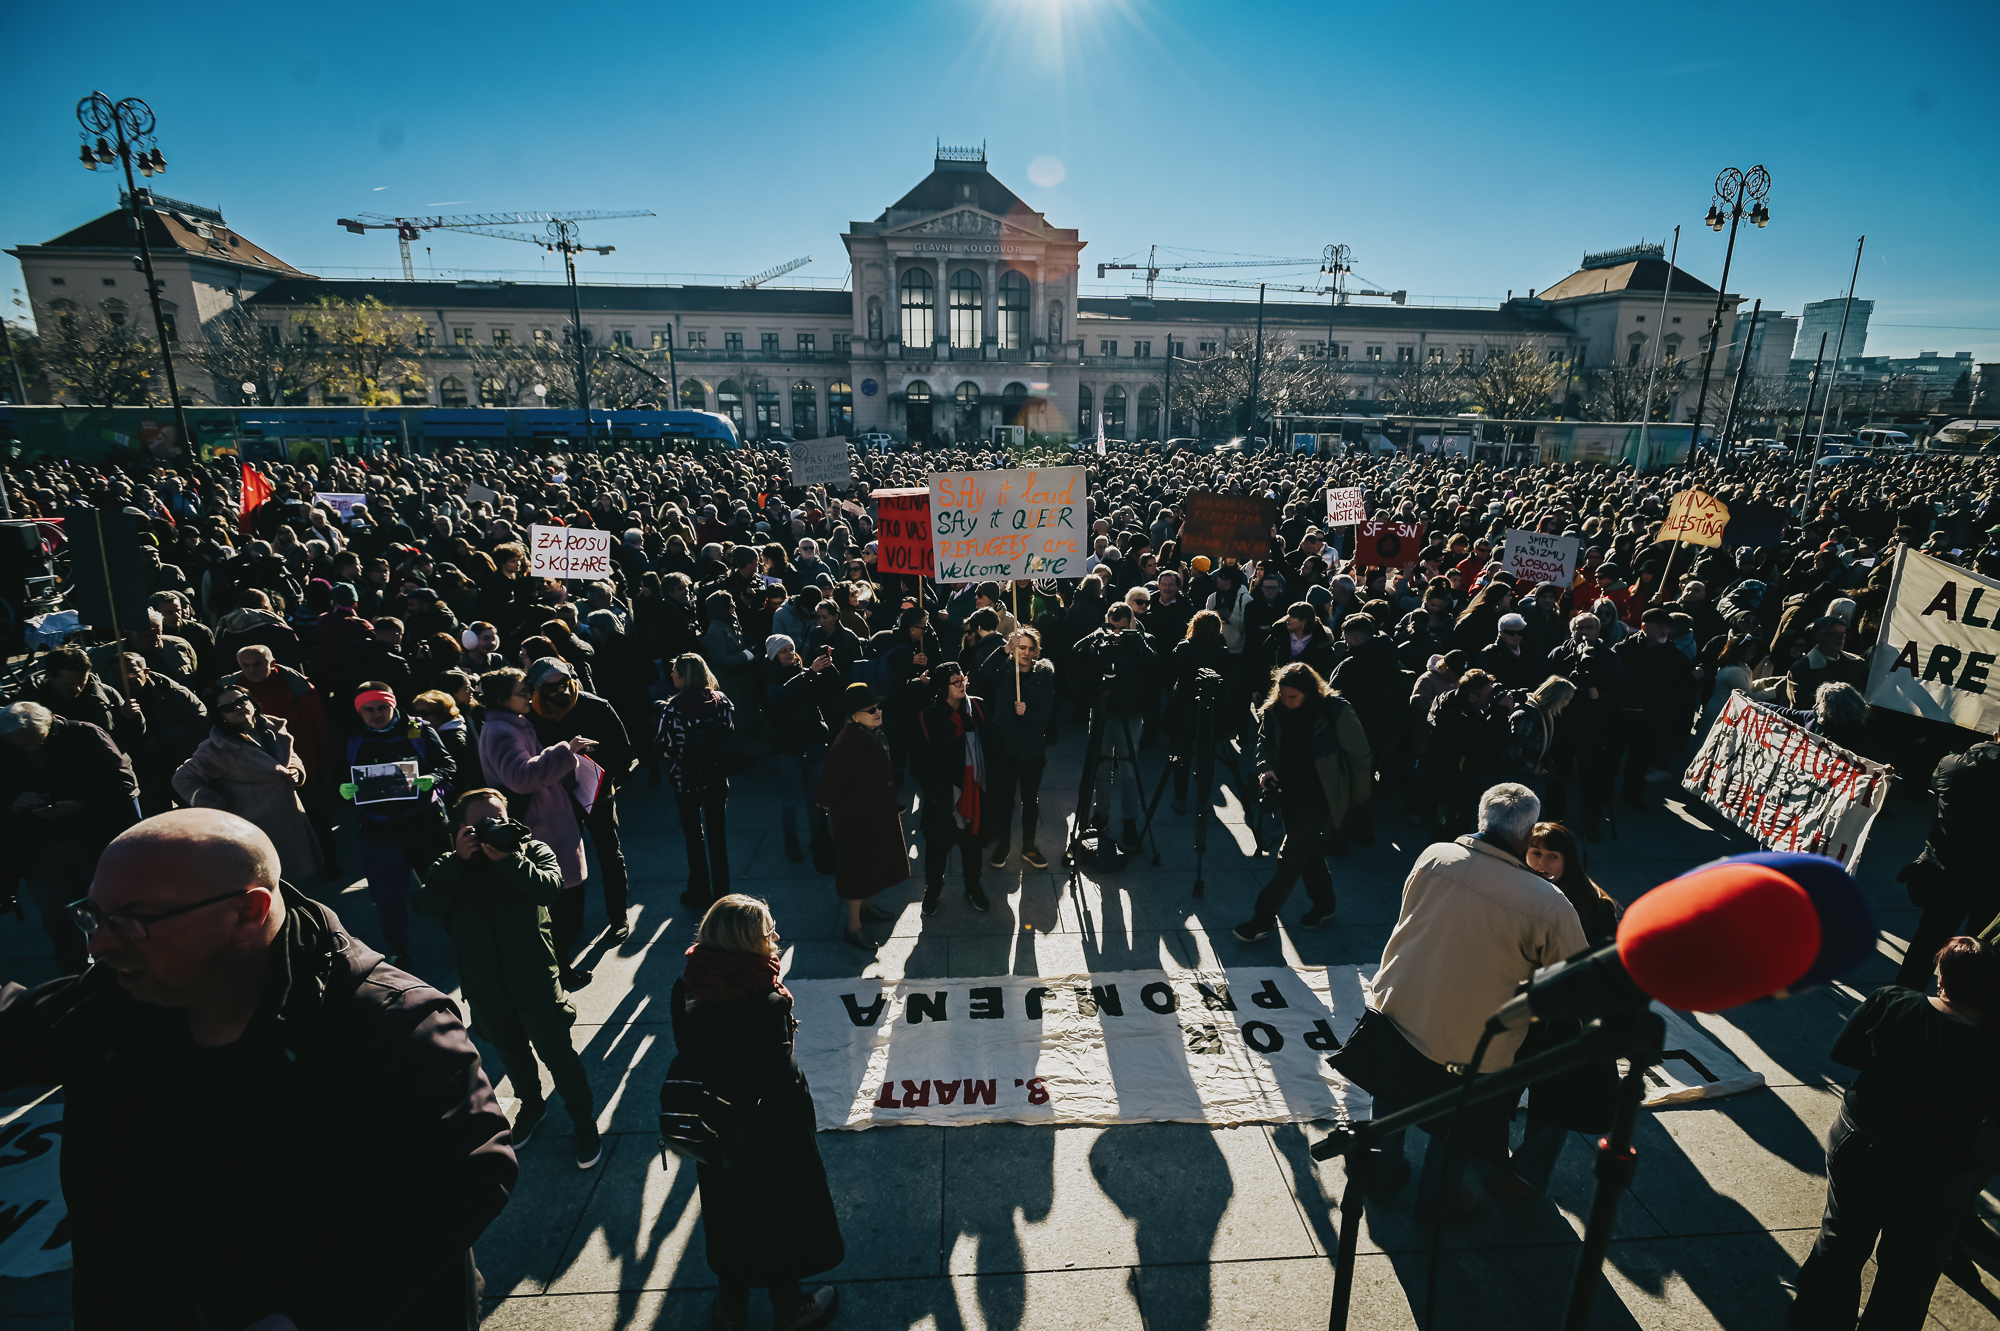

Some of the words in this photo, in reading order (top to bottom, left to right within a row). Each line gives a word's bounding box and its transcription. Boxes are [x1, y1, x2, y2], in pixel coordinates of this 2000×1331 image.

[914, 242, 952, 252] GLAVNI
[963, 244, 1022, 254] KOLODVOR
[999, 479, 1014, 506] it
[1021, 471, 1076, 505] loud
[1679, 492, 1721, 513] VIVA
[878, 518, 900, 538] TKO
[905, 519, 927, 541] VAS
[990, 508, 1004, 529] it
[1012, 506, 1076, 530] QUEER
[537, 532, 563, 551] ZA
[564, 534, 608, 552] ROSU
[1211, 525, 1236, 536] BEZ
[1527, 535, 1558, 549] SMRT
[937, 534, 1033, 562] REFUGEES
[1043, 538, 1079, 554] are
[1515, 545, 1566, 561] FAŠIZMU
[1510, 554, 1566, 578] SLOBODA
[1515, 568, 1558, 582] NARODU
[1889, 640, 1997, 695] ARE
[839, 978, 1291, 1028] PROMJENA
[872, 1078, 999, 1109] MART
[1013, 1077, 1051, 1106] 8.
